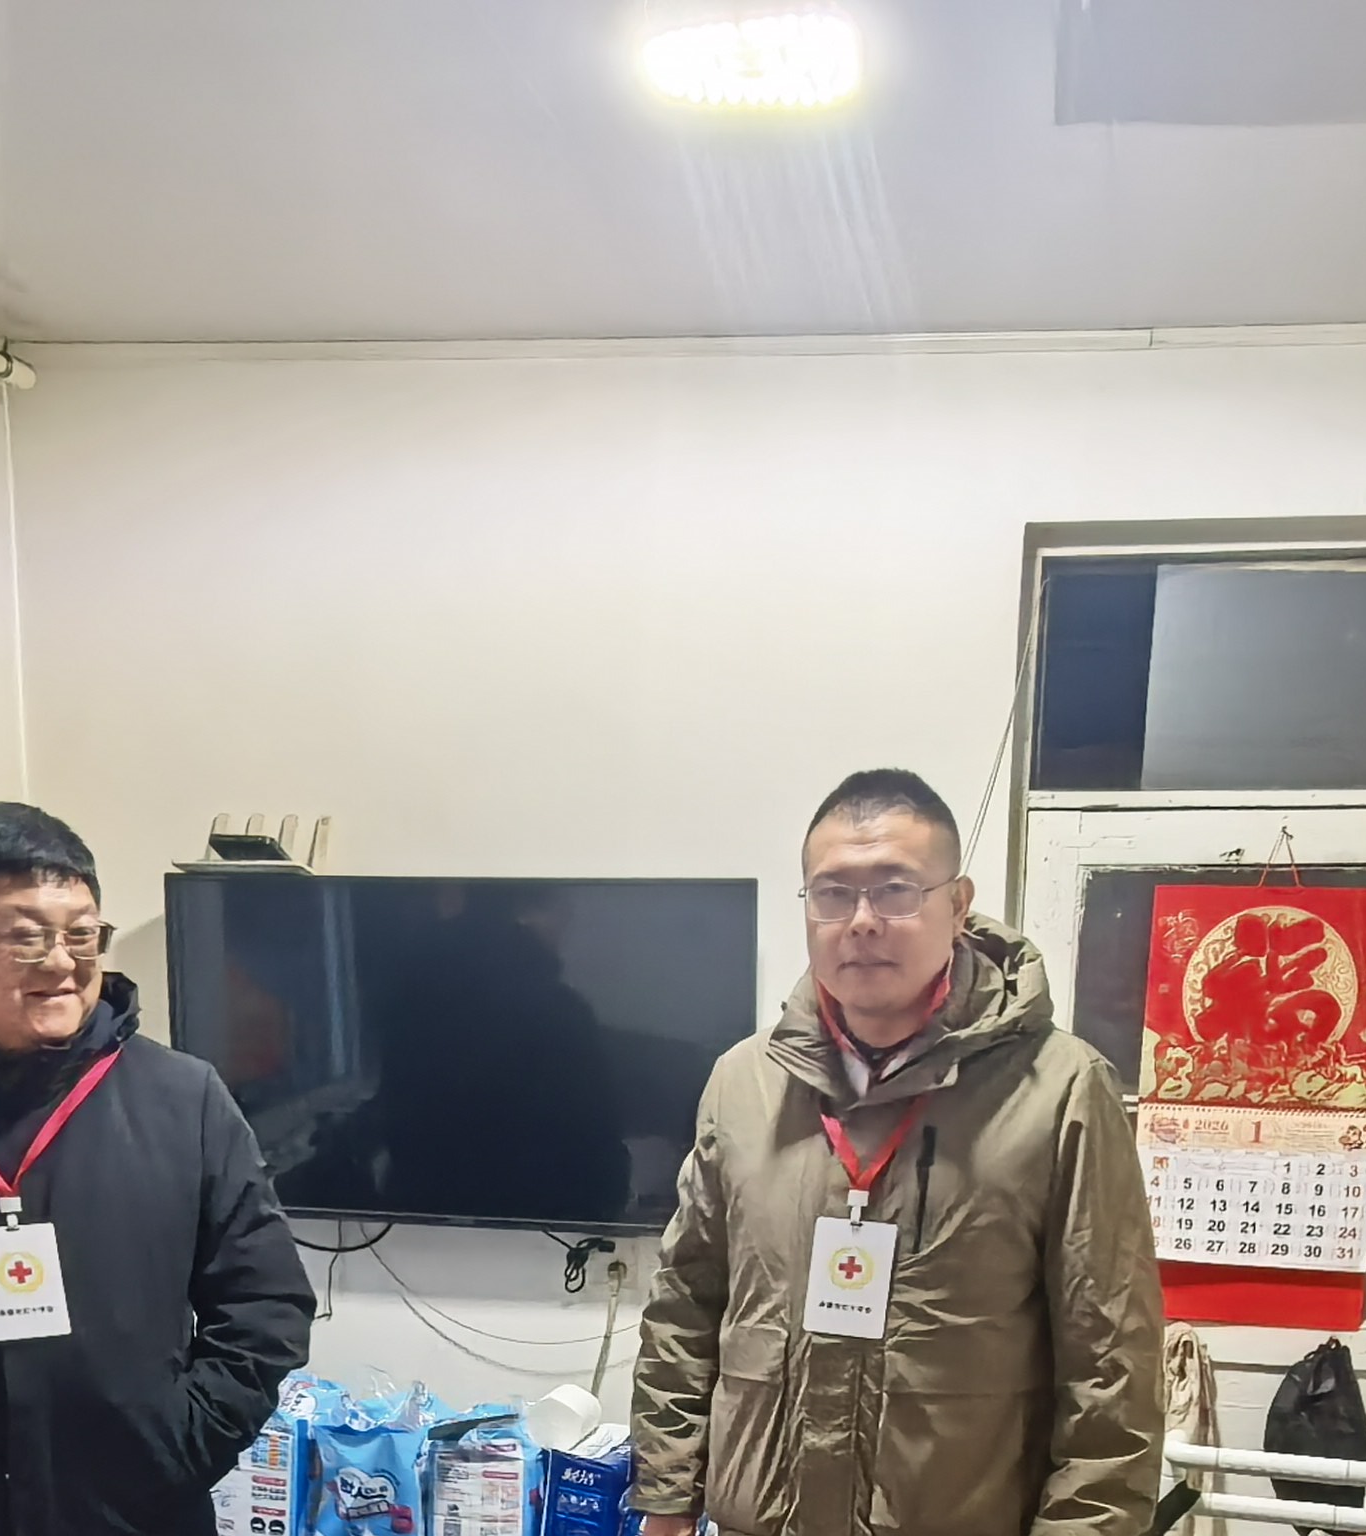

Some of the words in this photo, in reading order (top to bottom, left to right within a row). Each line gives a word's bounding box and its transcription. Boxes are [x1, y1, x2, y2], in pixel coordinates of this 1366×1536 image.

[1194, 1119, 1229, 1133] 2026
[1250, 1120, 1263, 1144] 1
[1284, 1161, 1291, 1174] 1
[1316, 1163, 1326, 1176] 2
[1349, 1164, 1359, 1178] 3
[1150, 1175, 1160, 1188] 4
[1183, 1177, 1192, 1190] 5
[1215, 1179, 1225, 1192] 6
[1249, 1180, 1258, 1193] 7
[1281, 1182, 1291, 1195] 8
[1314, 1183, 1324, 1197] 9
[1345, 1185, 1361, 1198] 10
[1178, 1197, 1195, 1211] 12
[1210, 1199, 1227, 1212] 13
[1242, 1200, 1260, 1213] 14
[1276, 1202, 1293, 1216] 15
[1309, 1204, 1326, 1218] 16
[1341, 1206, 1359, 1219] 17
[1152, 1215, 1161, 1229] 8
[1177, 1217, 1194, 1230] 19
[1207, 1219, 1226, 1233] 20
[1240, 1221, 1257, 1234] 21
[1273, 1222, 1291, 1236] 22
[1305, 1224, 1324, 1238] 23
[1338, 1226, 1357, 1240] 24
[1174, 1237, 1192, 1251] 26
[1206, 1239, 1225, 1253] 27
[1238, 1241, 1256, 1254] 28
[1271, 1243, 1289, 1256] 29
[1304, 1245, 1322, 1258] 30
[1336, 1246, 1354, 1260] 31
